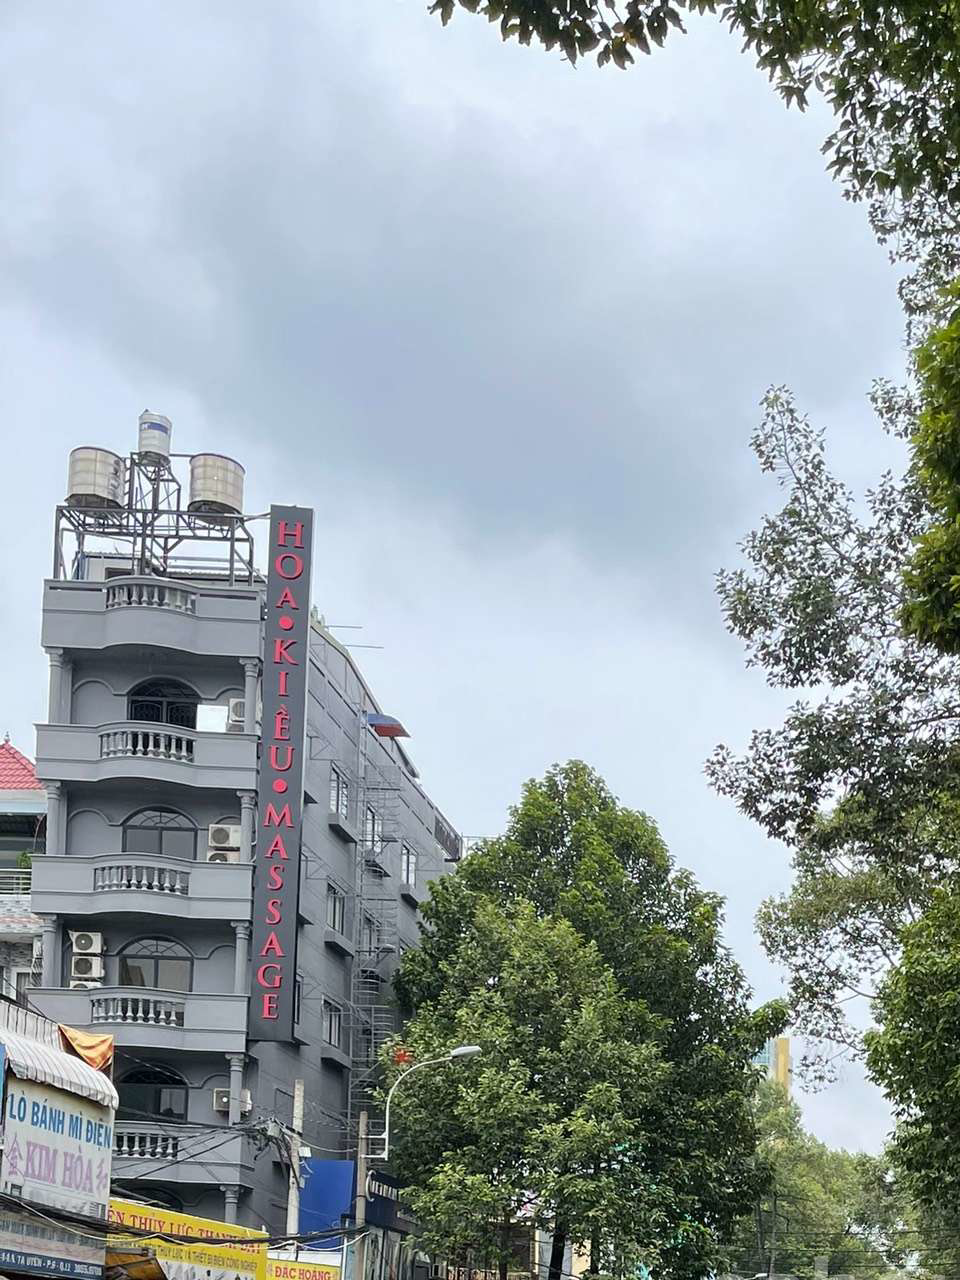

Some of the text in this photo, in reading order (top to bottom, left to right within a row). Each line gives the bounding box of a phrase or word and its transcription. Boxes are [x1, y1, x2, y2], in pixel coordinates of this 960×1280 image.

[256, 520, 305, 1020] HOA KIỀU MASSAGE
[9, 1090, 112, 1151] LÒ BÁNH MÌ ĐIỆN
[25, 1140, 59, 1185] KIM
[63, 1145, 95, 1194] HÒA
